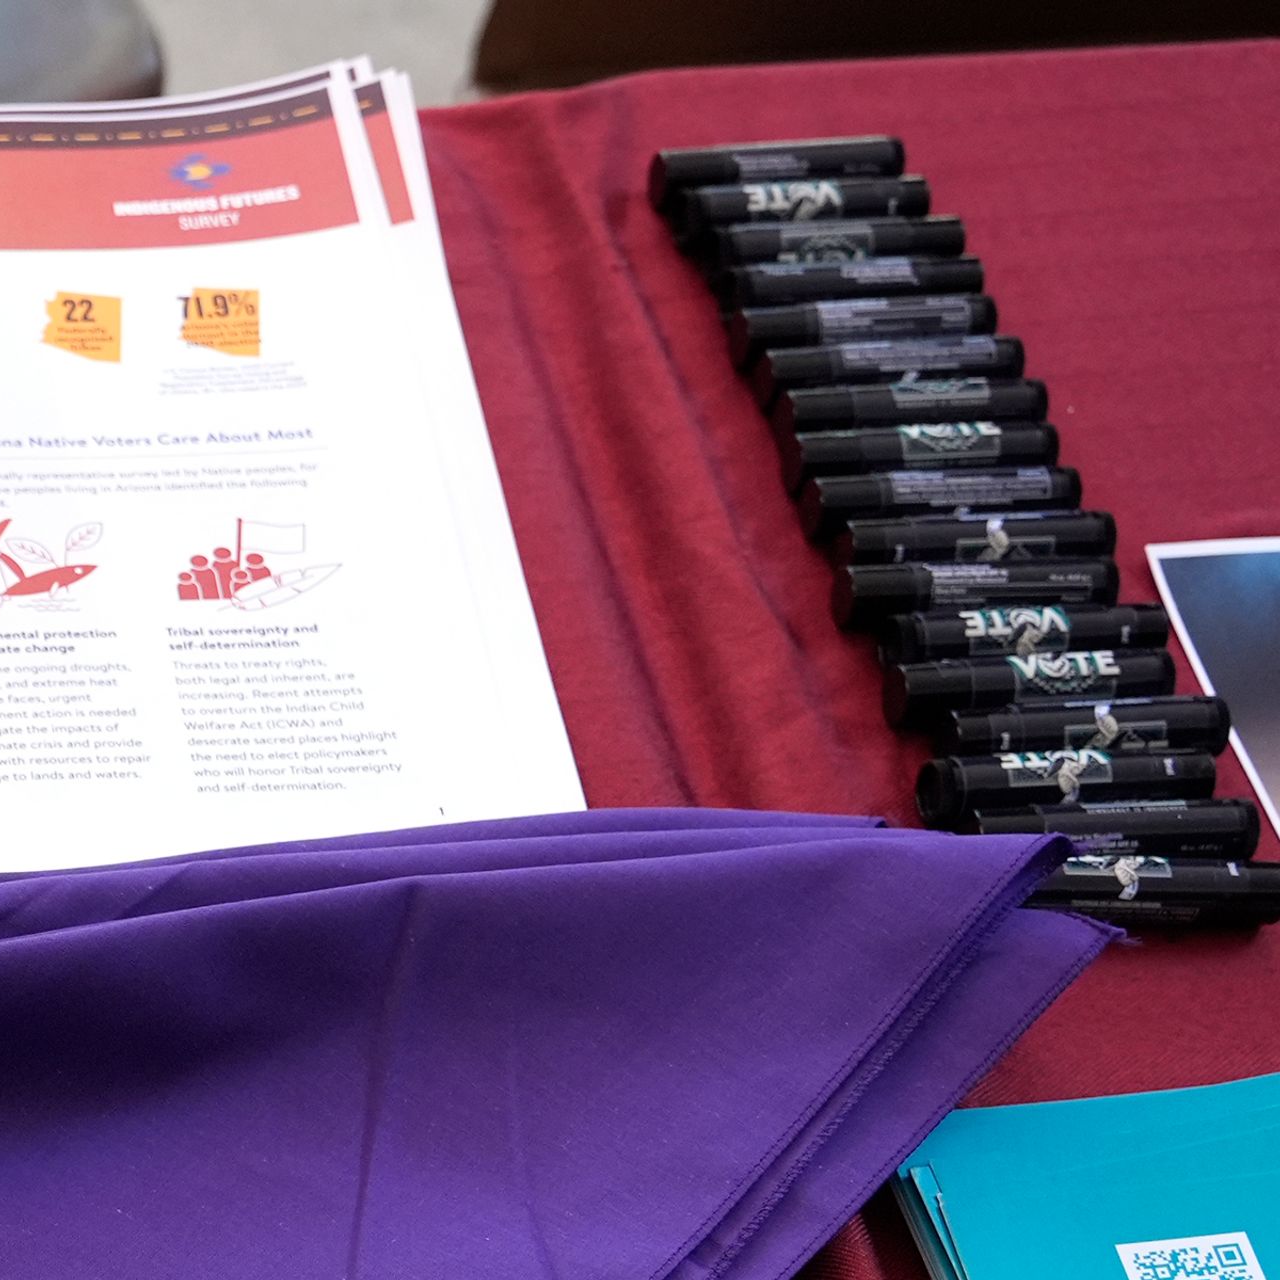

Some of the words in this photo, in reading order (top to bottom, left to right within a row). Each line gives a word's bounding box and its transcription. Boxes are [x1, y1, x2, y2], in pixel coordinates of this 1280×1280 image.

[220, 183, 301, 210] FUTURES
[178, 210, 240, 231] SURVEY
[62, 299, 96, 322] 22
[177, 291, 256, 320] 71.9%
[27, 434, 87, 448] Native
[91, 433, 151, 446] Voters
[156, 431, 200, 444] Care
[205, 430, 260, 443] About
[266, 428, 312, 441] Most
[166, 625, 204, 638] Tribal
[207, 623, 289, 638] sovereignty
[292, 622, 318, 634] and
[958, 606, 1068, 637] VOTE
[42, 628, 117, 641] protection
[168, 637, 300, 651] self-determination
[24, 643, 75, 656] change
[1007, 650, 1121, 680] VOTE
